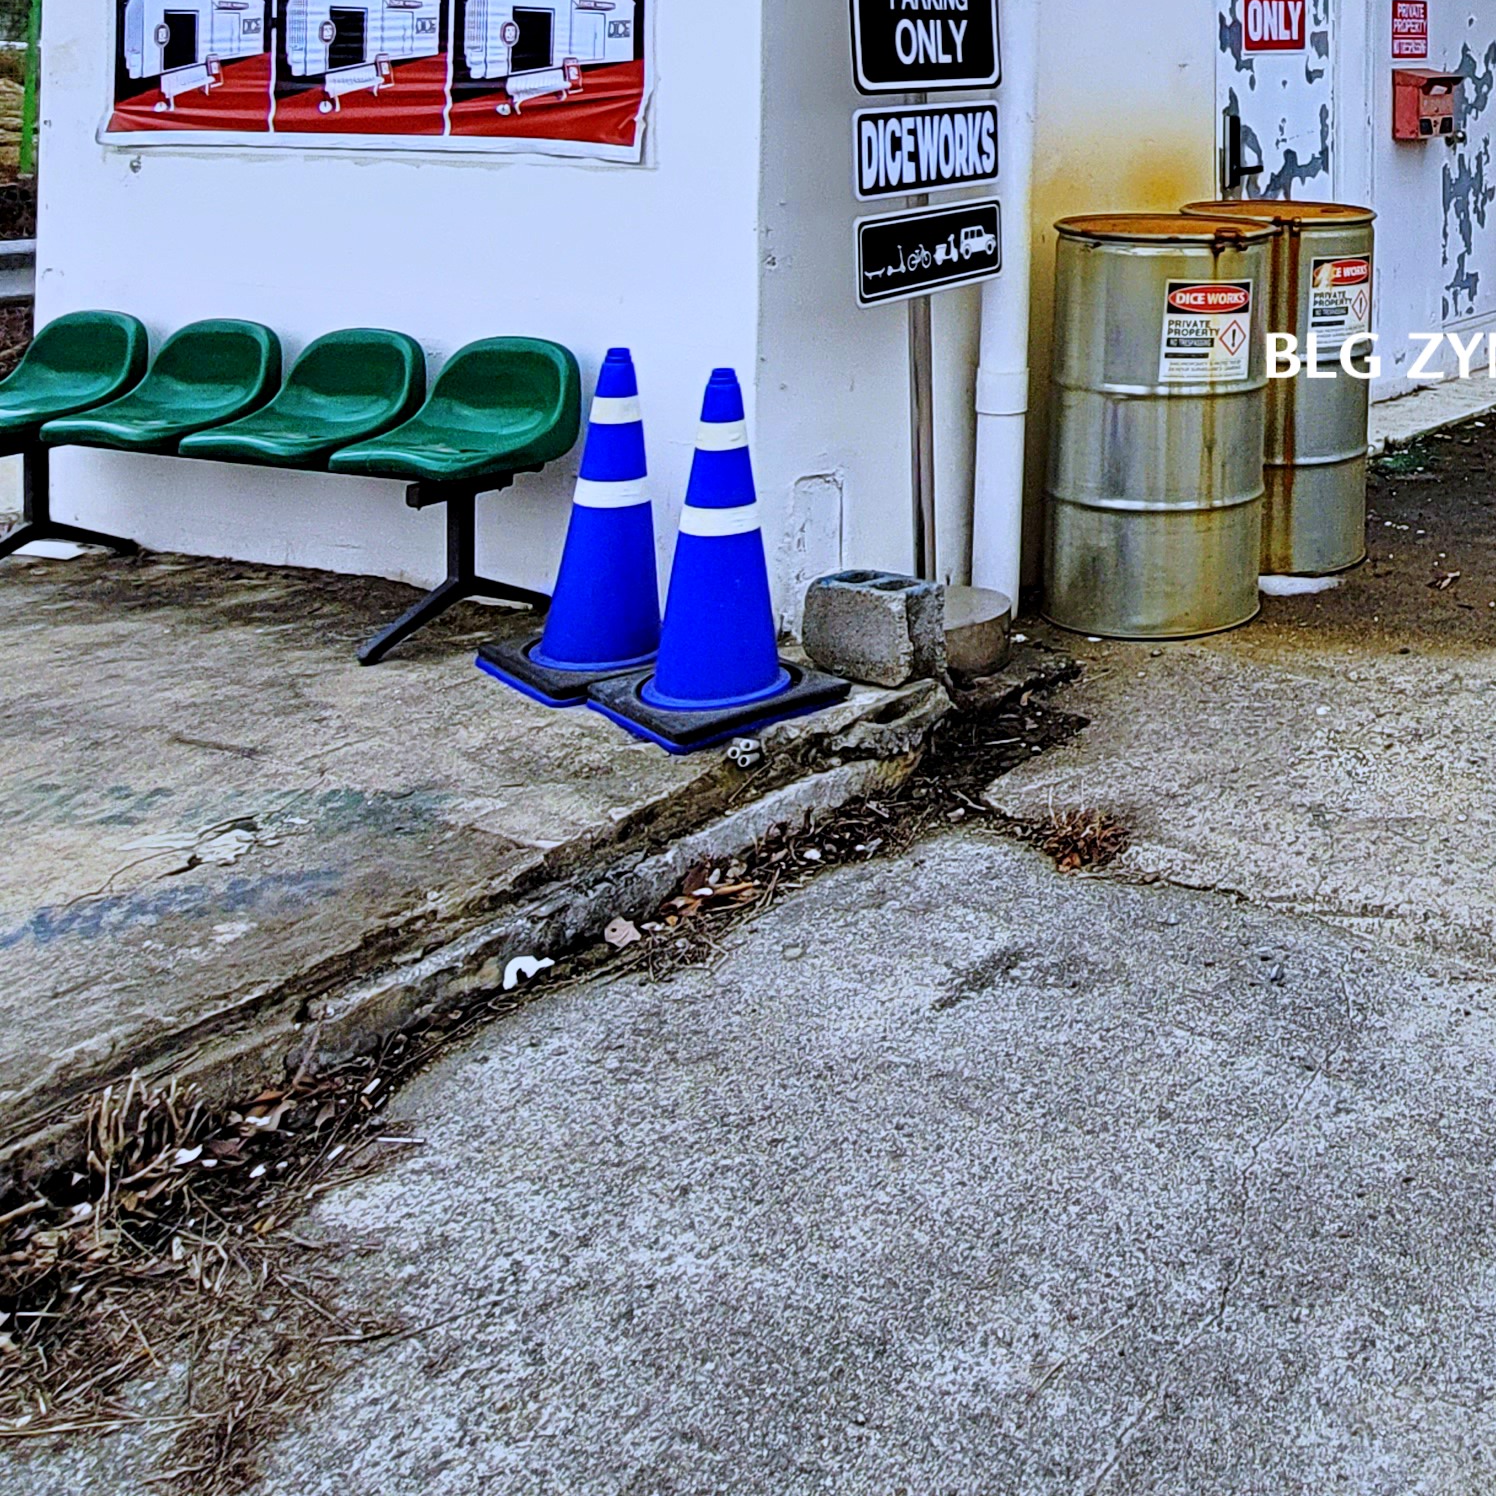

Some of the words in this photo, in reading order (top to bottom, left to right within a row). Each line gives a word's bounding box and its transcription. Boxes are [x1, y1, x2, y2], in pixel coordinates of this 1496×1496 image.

[1247, 0, 1303, 42] ONLY
[895, 18, 968, 65] ONLY
[861, 110, 996, 190] DICEWORKS
[1343, 265, 1368, 278] WORKS
[1175, 293, 1205, 305] DICE
[1207, 292, 1246, 305] WORKS
[1314, 290, 1347, 300] PRIVATE
[1168, 320, 1212, 329] PRIVATE
[1167, 328, 1220, 337] PROPERTY
